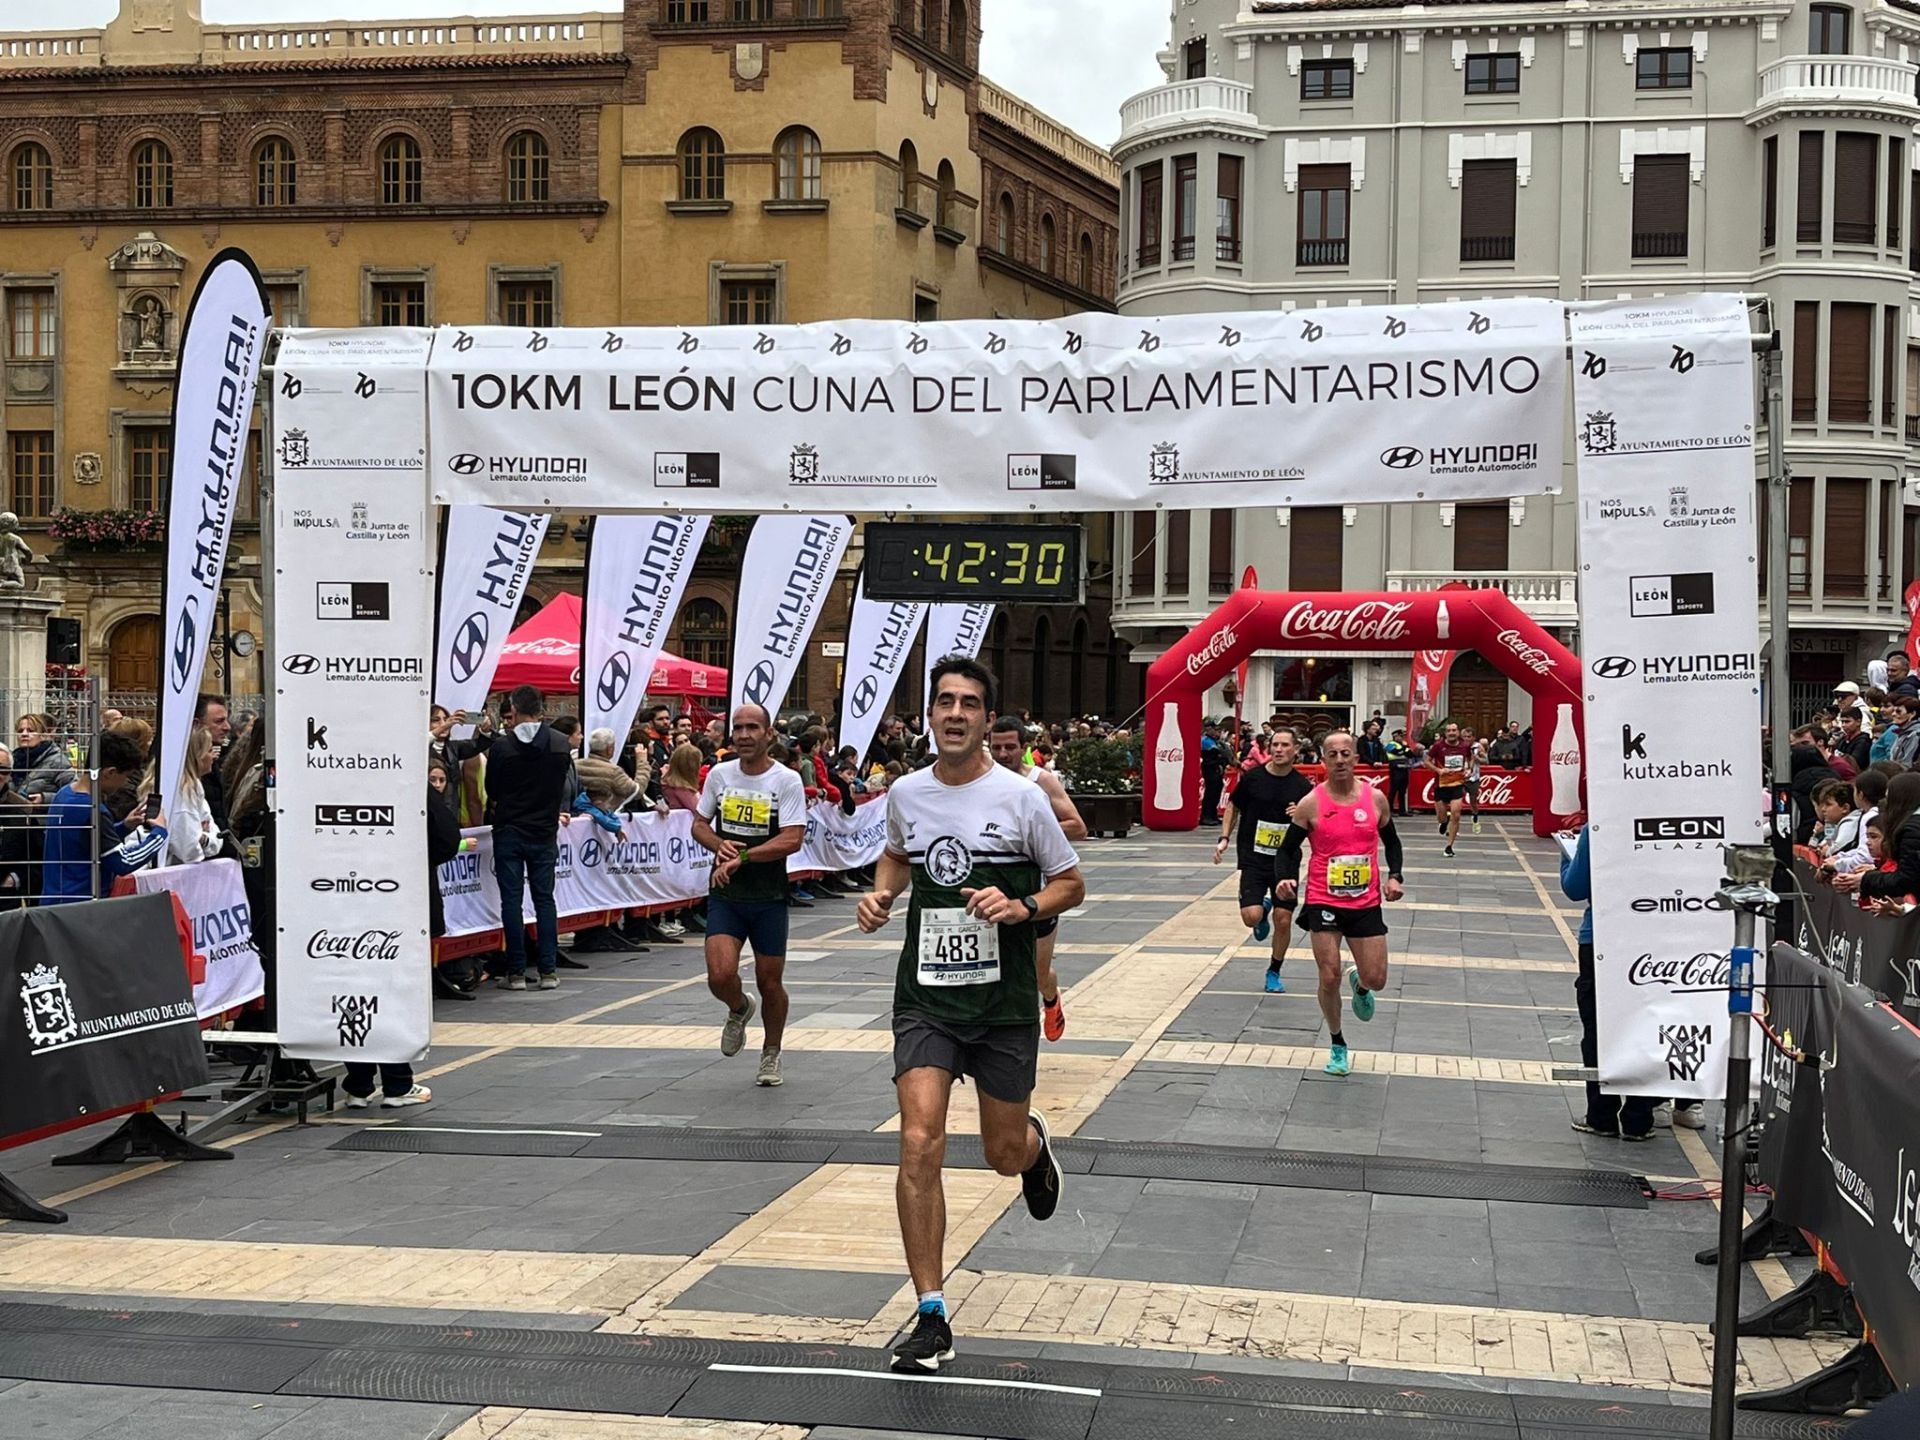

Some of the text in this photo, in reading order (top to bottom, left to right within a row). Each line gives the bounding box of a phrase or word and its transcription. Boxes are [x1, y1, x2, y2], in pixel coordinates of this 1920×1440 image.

[451, 355, 1540, 414] 10KM LEÓN CUNA DEL PARLAMENTARISMO
[192, 314, 248, 581] HYUNDAI
[1620, 434, 1751, 450] AYUNTAMIENTO DE LEÓN
[400, 456, 423, 466] LEÓN
[1430, 444, 1538, 465] HYUNDAI
[490, 456, 586, 474] HYUNDAI
[658, 462, 684, 474] LEÓN
[1011, 464, 1039, 478] LEÓN
[1182, 466, 1305, 480] AYUNTAMIENTO DE LEÓN
[1430, 462, 1538, 474] Lemauto Automoción
[490, 474, 586, 482] Lemauto Automoción
[820, 472, 938, 484] AYUNTAMIENTO DE LEÓN
[1600, 499, 1622, 507] NOS
[1691, 506, 1736, 516] Junta de
[370, 522, 410, 530] Junta de
[1663, 516, 1736, 528] Castilla y León
[202, 485, 229, 590] Lemauto
[346, 532, 378, 540] Castilla
[387, 532, 410, 540] León
[500, 534, 535, 609] Lemauto
[618, 515, 682, 644] HYUND
[640, 586, 671, 648] Lemauto
[665, 516, 697, 582] Automoc
[764, 518, 830, 655] HYUNDAI
[320, 594, 350, 606] LEÓN
[784, 526, 842, 658] Lemauto Automoción
[1636, 588, 1668, 601] LEÓN
[1280, 600, 1414, 640] Coca-Cola
[869, 602, 909, 671] HYUN
[885, 630, 908, 674] Lemauto
[1187, 624, 1237, 675] Coca-Cola
[1497, 630, 1557, 676] Coca-Cola
[326, 658, 422, 673] HYUNDAI
[1644, 654, 1754, 674] HYUNDAI
[368, 674, 422, 682] Automoción
[1644, 672, 1755, 684] Lemauto Automoción
[308, 753, 402, 770] kutxabank
[1624, 760, 1732, 780] kutxabank
[318, 807, 392, 823] LEON
[736, 804, 753, 822] 79
[1638, 820, 1722, 836] LEON
[1268, 834, 1280, 846] 78
[1634, 842, 1724, 850] PLAZA
[311, 872, 400, 892] emico
[1344, 870, 1360, 886] 58
[307, 930, 402, 960] Coca-Cola
[936, 934, 979, 962] 483
[948, 971, 986, 980] HYUNDAI
[1628, 953, 1731, 986] Coca-Cola
[332, 996, 378, 1014] KAM
[80, 1000, 195, 1036] AYUNTAMIENTO DE LEÓN
[338, 1013, 372, 1030] ARI
[340, 1030, 368, 1047] NY
[1659, 1024, 1712, 1045] KAM
[1665, 1044, 1705, 1063] ARI
[1669, 1062, 1700, 1082] NY
